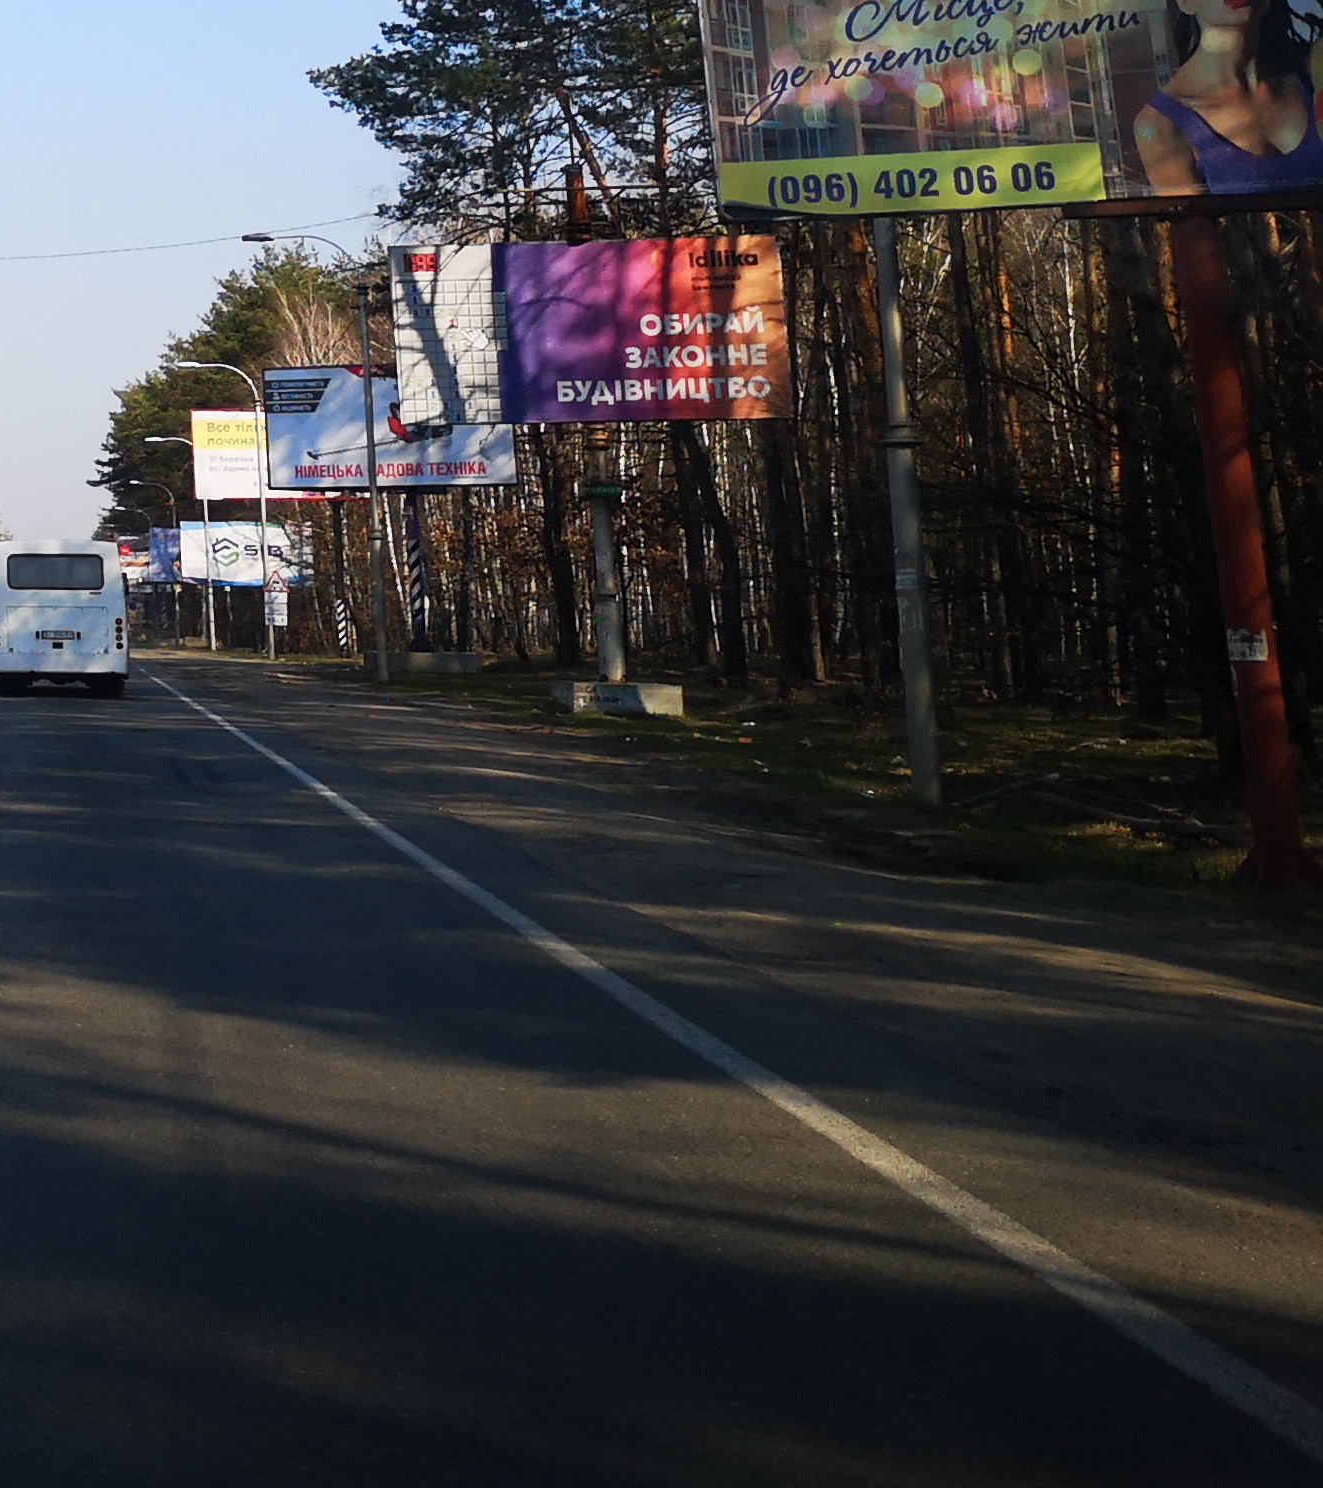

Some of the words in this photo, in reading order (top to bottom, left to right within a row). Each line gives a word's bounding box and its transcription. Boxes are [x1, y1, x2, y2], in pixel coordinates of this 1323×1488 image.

[743, 68, 815, 128] де
[824, 31, 1002, 85] хочеться
[1016, 9, 1143, 47] жити
[767, 171, 859, 209] (096)
[873, 167, 940, 199] 402
[953, 164, 997, 196] 06
[1011, 160, 1056, 193] 06
[639, 306, 765, 337] ОБИРАЙ
[624, 343, 768, 369] ЗАКОННЕ
[556, 376, 772, 406] БУДІВНИЦТВО
[207, 422, 230, 432] Все
[207, 437, 257, 446] почина
[294, 463, 364, 480] НІМЕЦЬКА
[375, 462, 424, 479] АДОВА
[427, 461, 487, 476] ТЕХНІКА
[244, 544, 283, 558] SB
